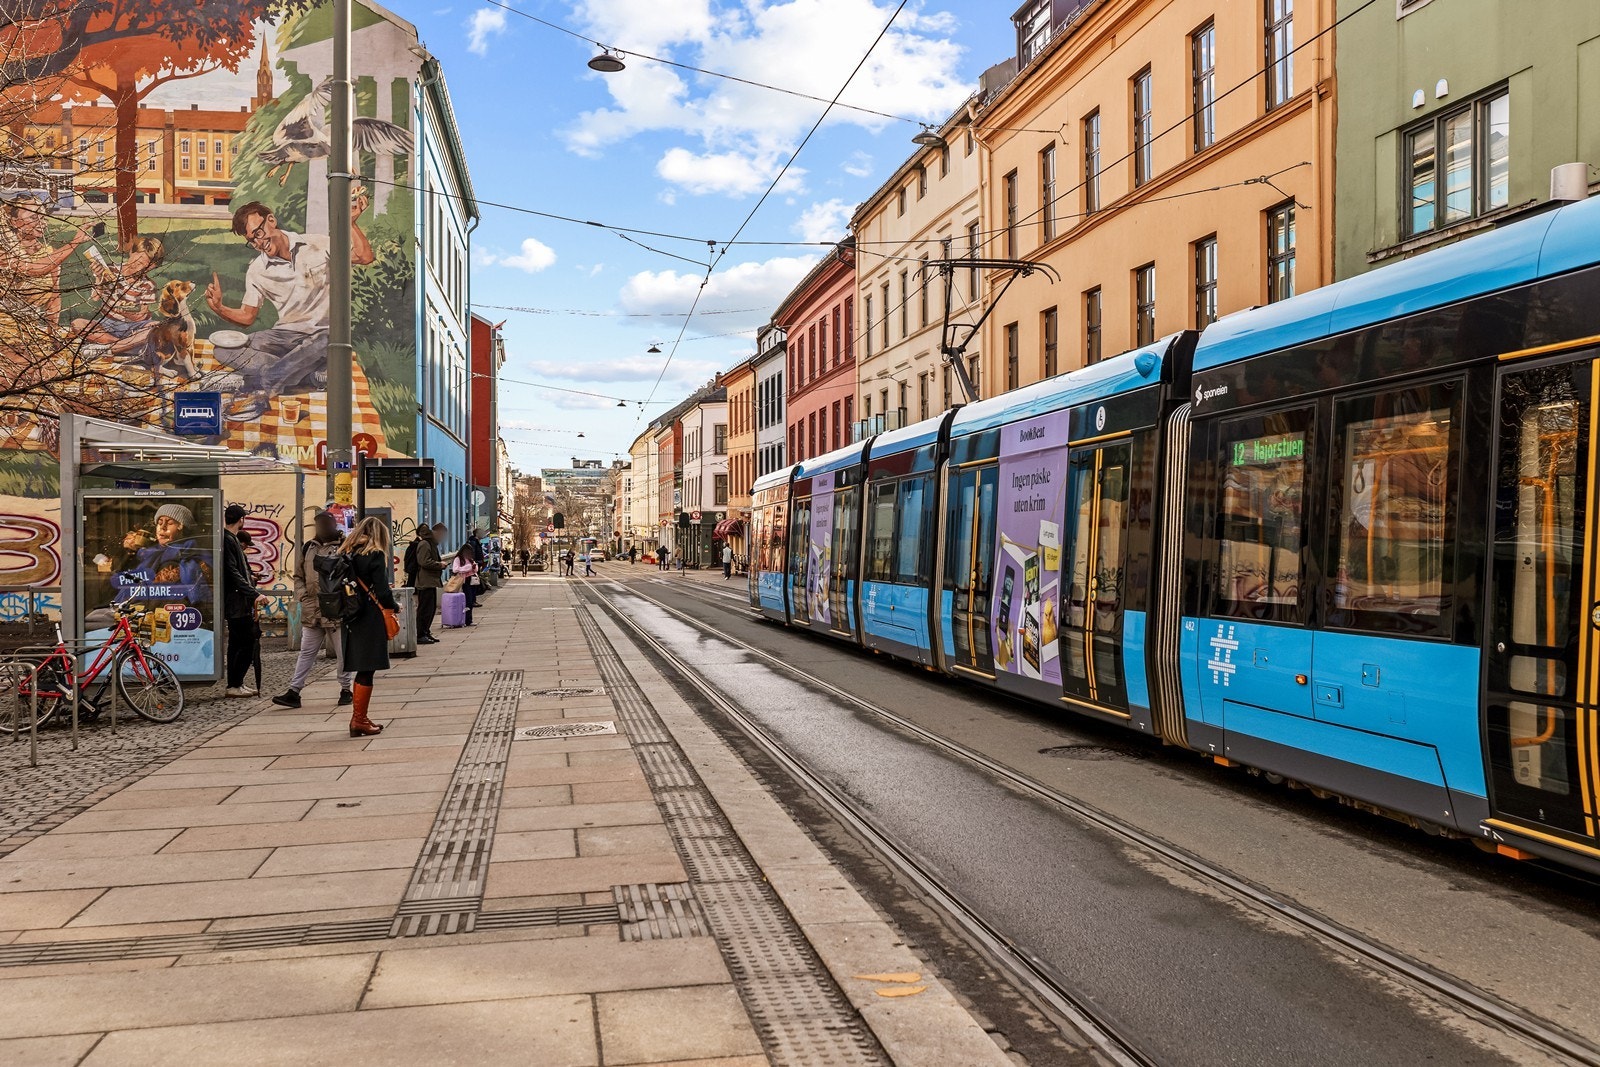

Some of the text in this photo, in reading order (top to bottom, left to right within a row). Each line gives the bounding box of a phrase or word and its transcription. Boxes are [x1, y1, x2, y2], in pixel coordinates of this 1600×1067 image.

[1203, 385, 1228, 401] sporveien
[1019, 426, 1045, 443] BookBeat
[1233, 438, 1303, 466] 12 Majorstuen
[1012, 467, 1051, 491] Ingen påske
[1013, 493, 1046, 513] uten krim
[149, 586, 171, 597] BARE
[175, 612, 189, 628] 39
[1185, 620, 1195, 631] 482
